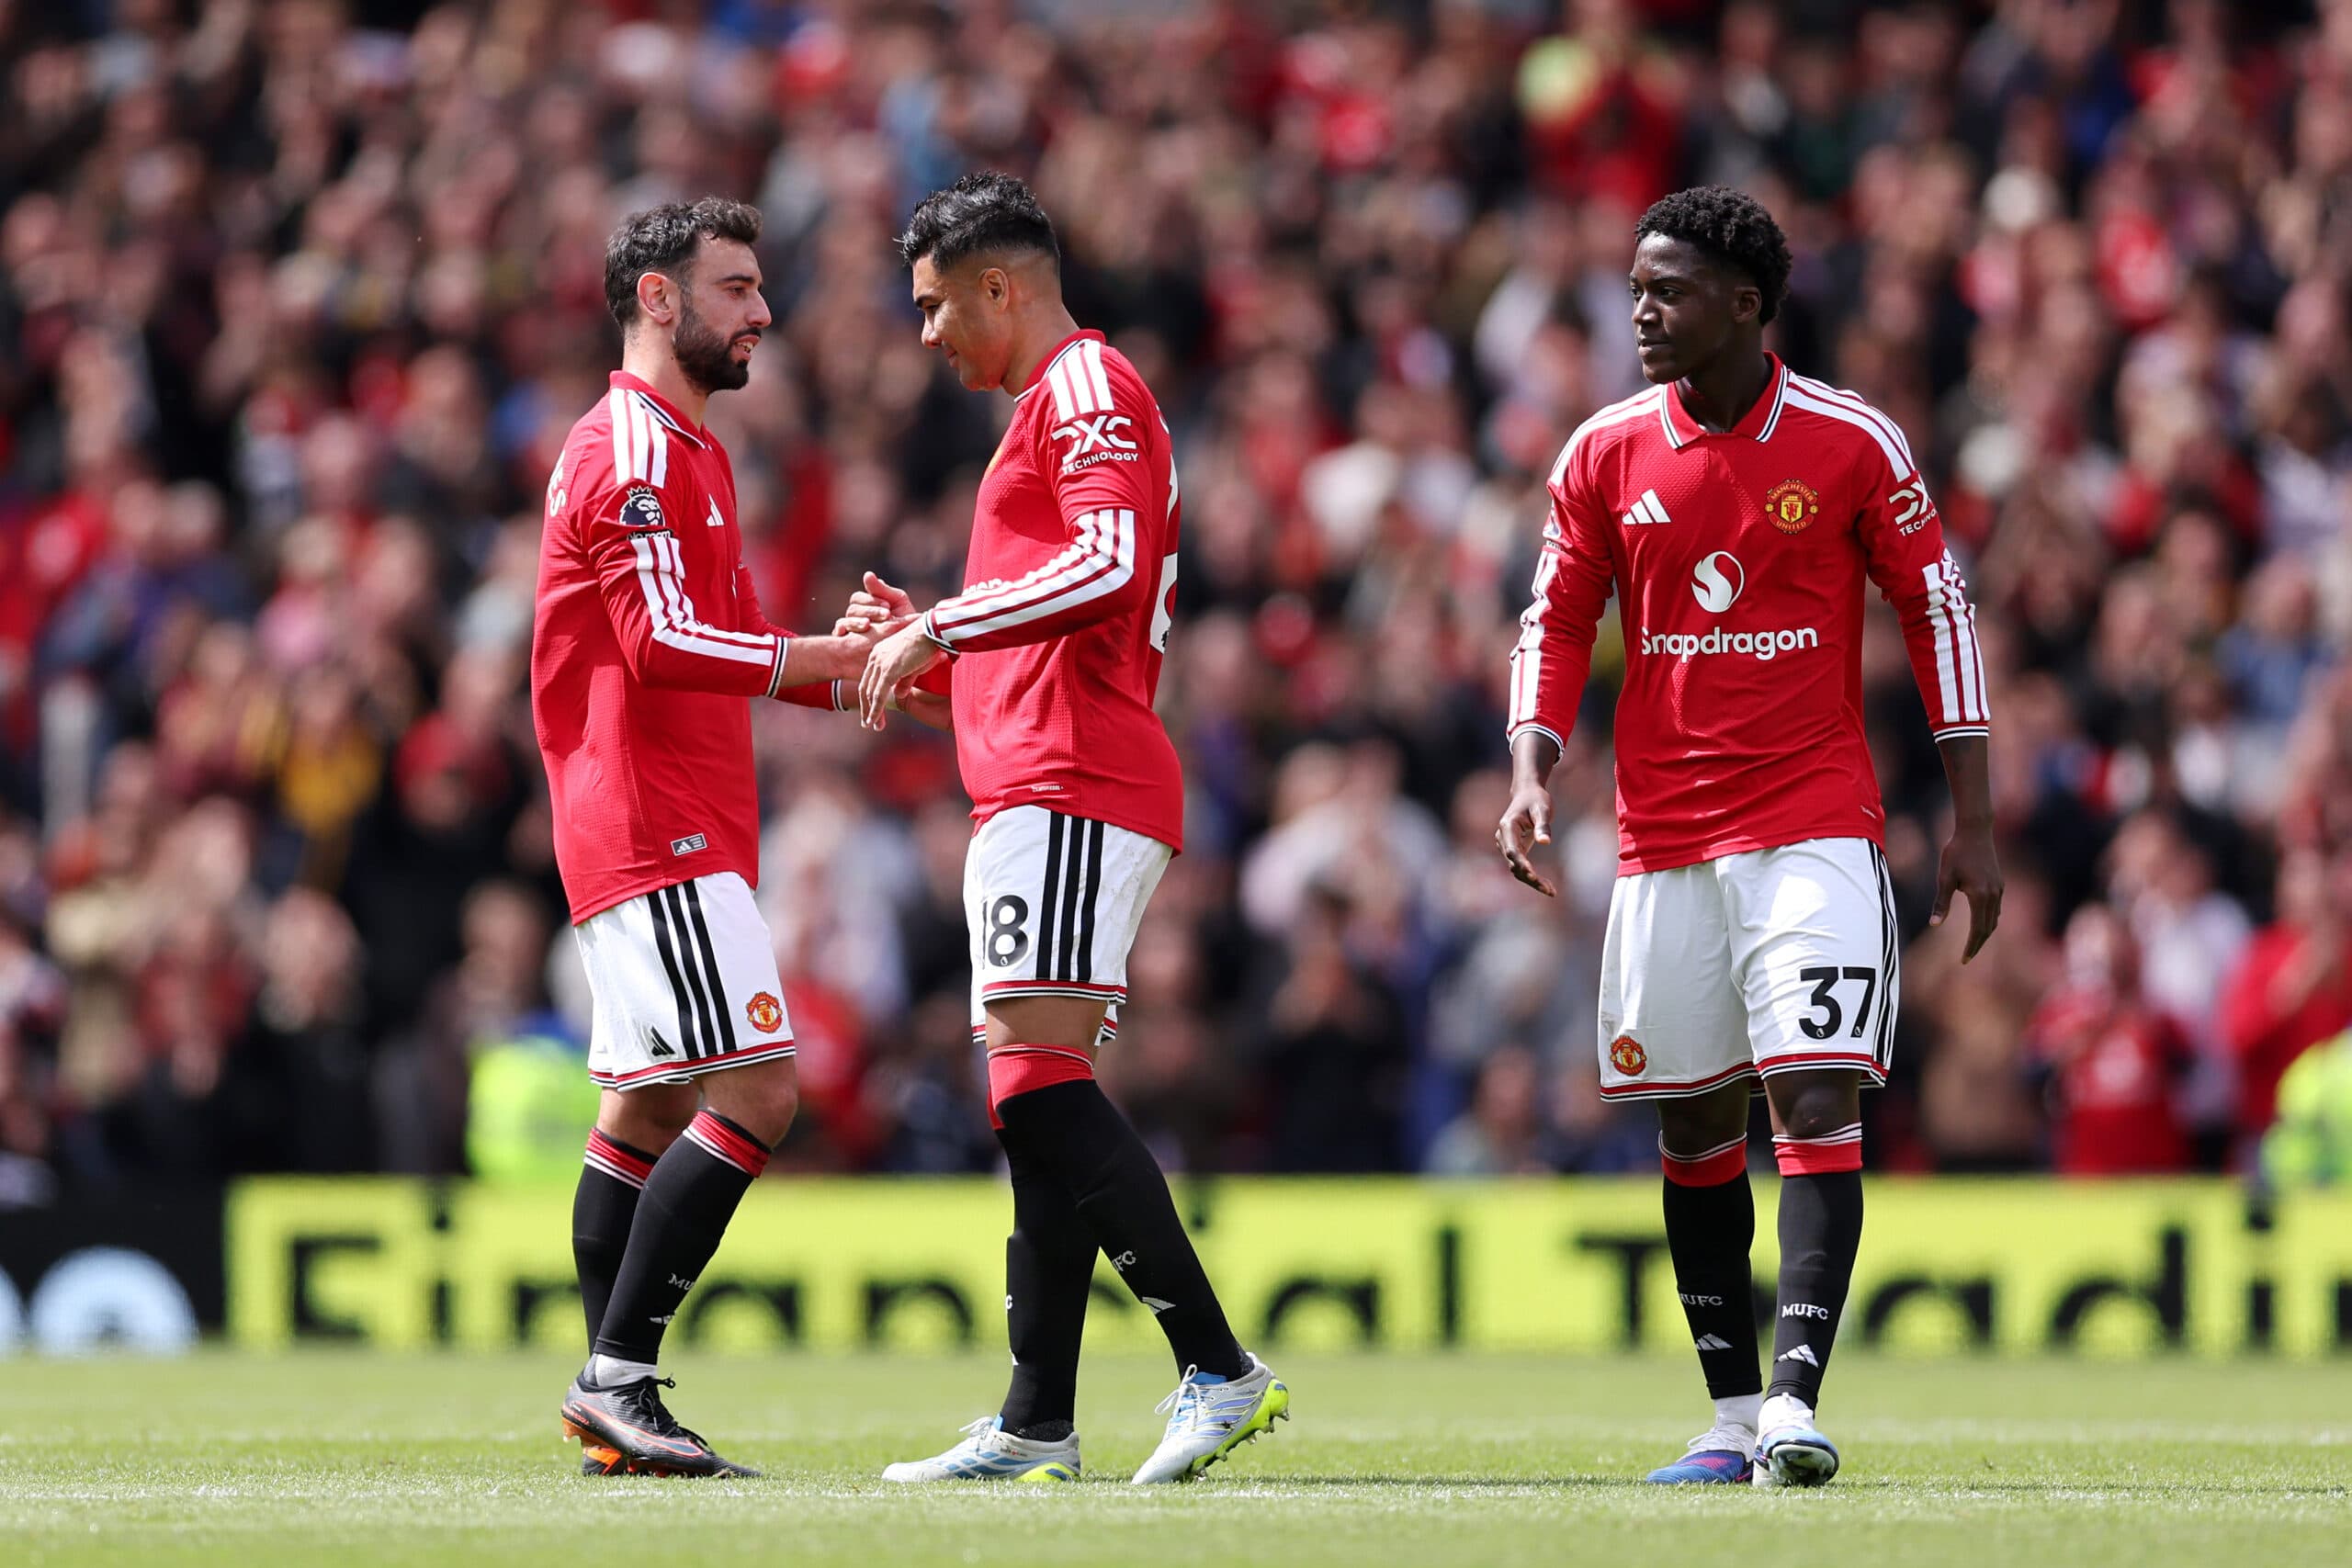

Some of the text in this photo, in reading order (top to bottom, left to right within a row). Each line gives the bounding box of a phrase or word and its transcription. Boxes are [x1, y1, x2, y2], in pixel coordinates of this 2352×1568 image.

[1051, 415, 1136, 465] DXC
[1062, 451, 1138, 474] TECHNOLOGY
[1776, 520, 1807, 530] UNITED
[1641, 626, 1818, 663] Snapdragon
[982, 894, 1029, 970] 8
[1798, 967, 1876, 1039] 37
[1112, 1250, 1136, 1271] FC
[1781, 1303, 1829, 1320] MUFC
